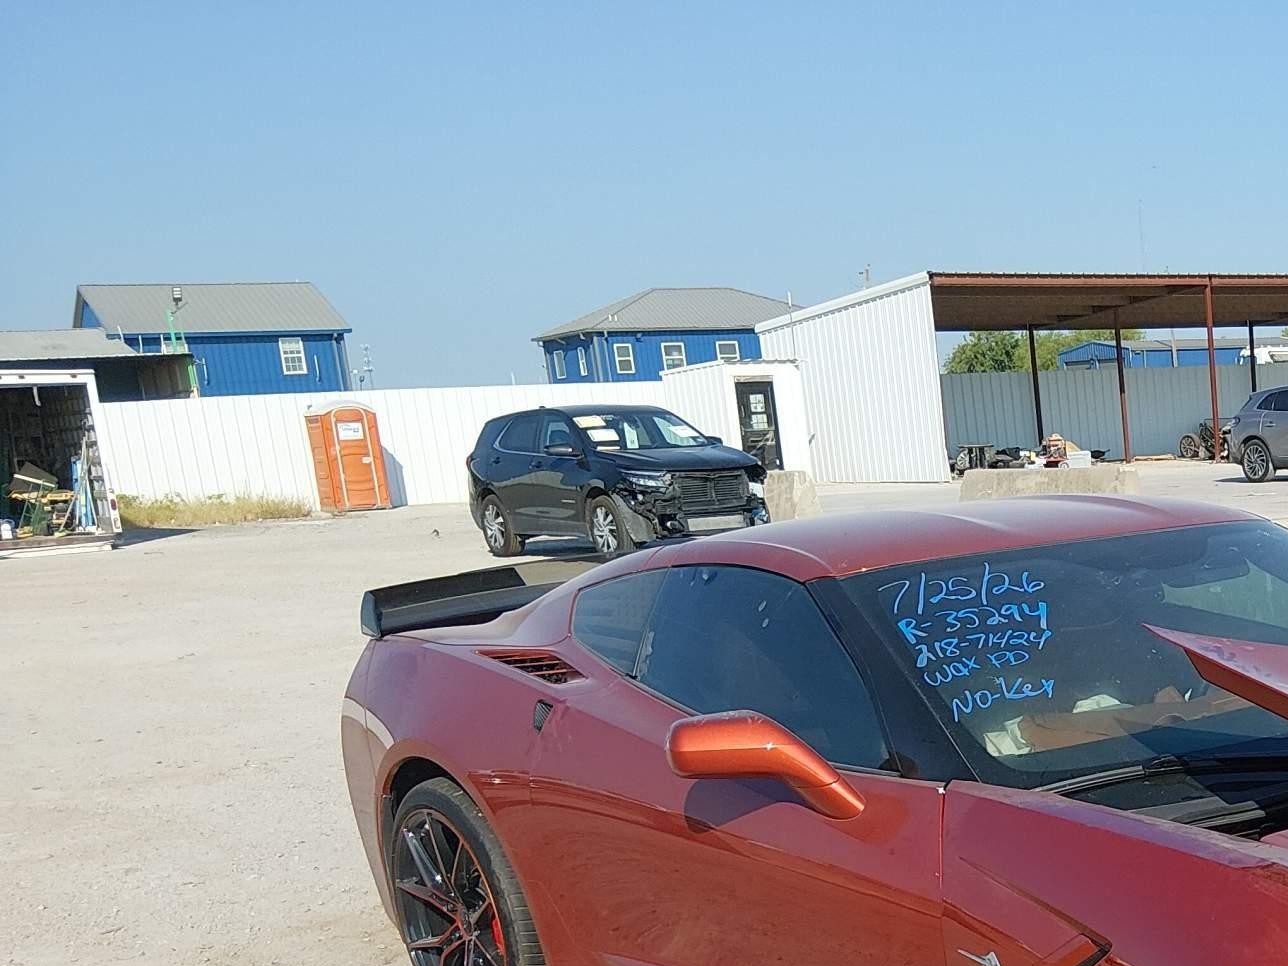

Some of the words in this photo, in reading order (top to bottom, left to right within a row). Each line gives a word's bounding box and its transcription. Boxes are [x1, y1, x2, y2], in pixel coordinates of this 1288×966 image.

[878, 562, 1045, 616] 7/25/26
[898, 600, 1047, 644] R-35294
[987, 650, 1029, 669] PD
